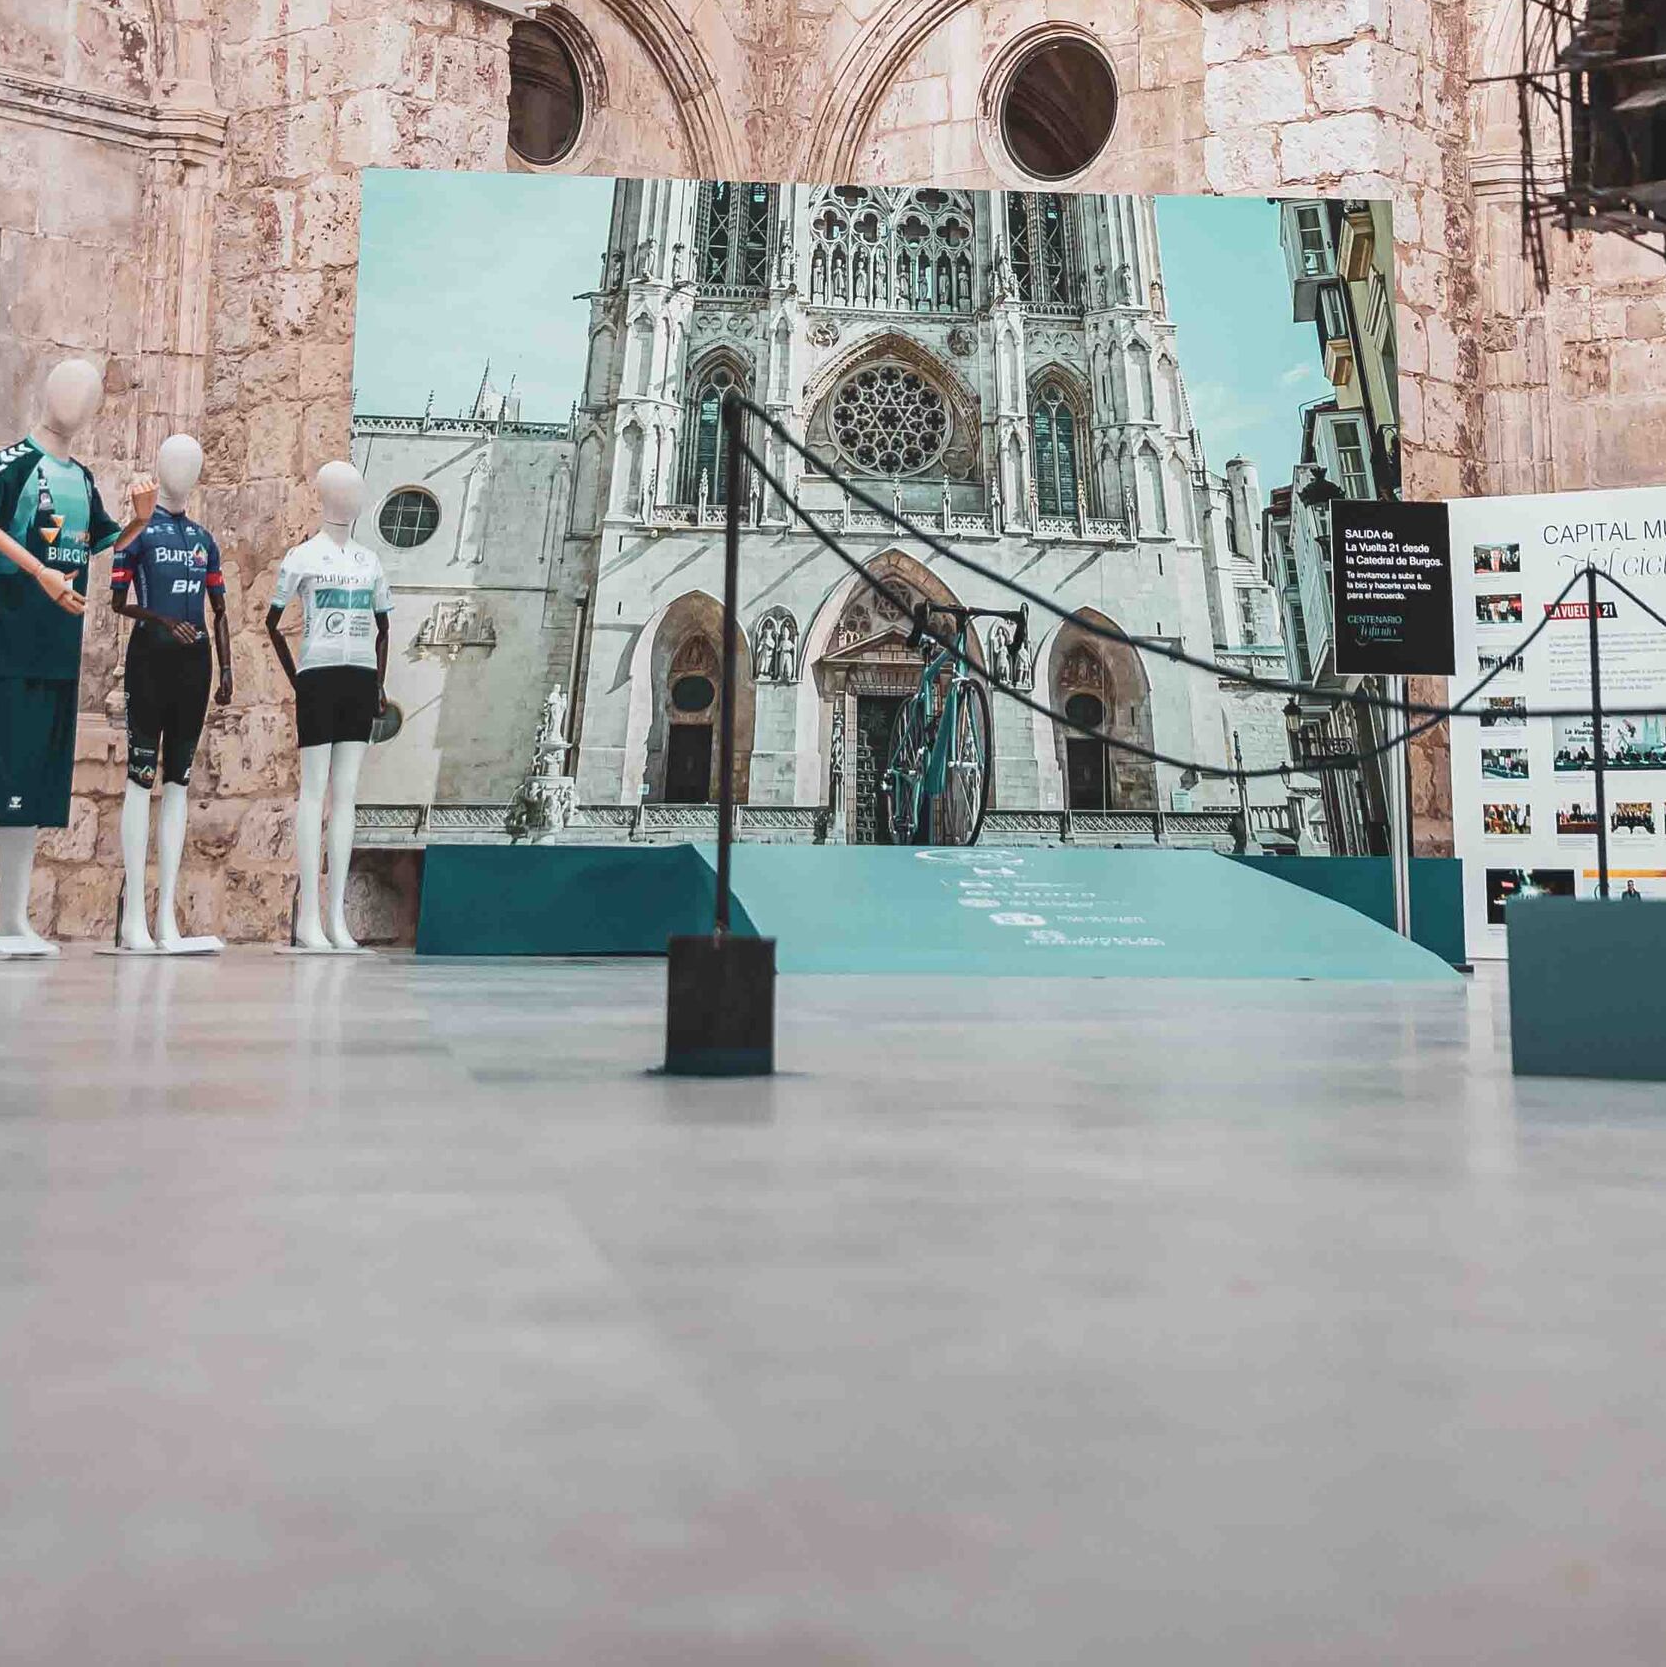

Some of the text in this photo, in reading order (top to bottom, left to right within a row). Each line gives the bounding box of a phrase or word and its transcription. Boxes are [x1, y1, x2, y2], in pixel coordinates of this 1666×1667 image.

[1345, 529, 1393, 540] SALIDA de
[1543, 520, 1638, 545] CAPITAL
[1345, 542, 1430, 553] La Vuelta 21 desde
[48, 546, 88, 565] BURGO
[1345, 555, 1444, 568] la Catedral de Burgos.
[1346, 571, 1355, 579] Te
[1356, 571, 1390, 580] invitamos
[1398, 572, 1415, 580] subir
[171, 579, 202, 594] BH
[1346, 592, 1364, 601] para
[1365, 591, 1372, 600] el
[1602, 604, 1614, 617] 21
[1347, 615, 1403, 624] CENTENARIO
